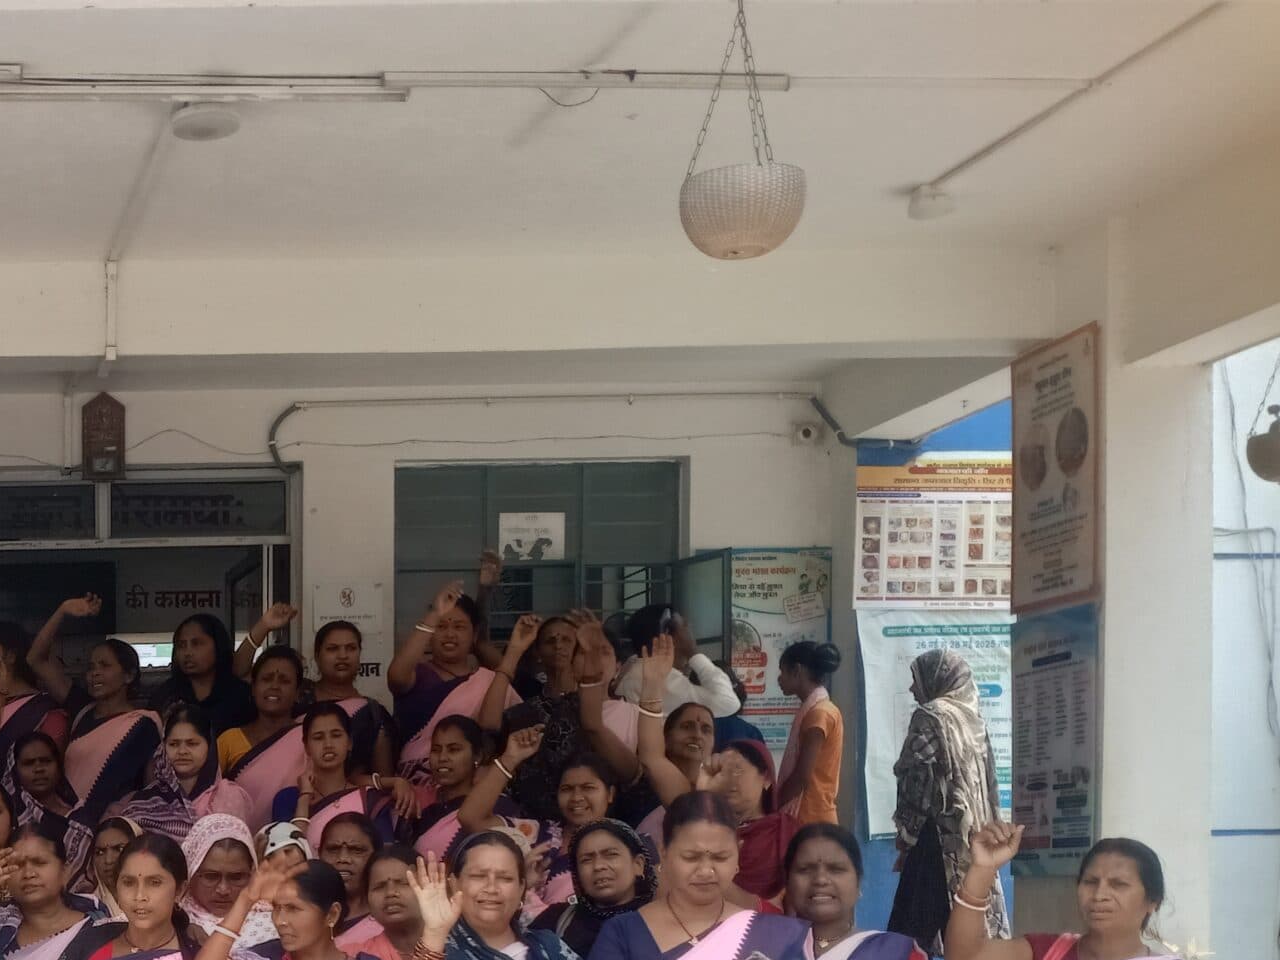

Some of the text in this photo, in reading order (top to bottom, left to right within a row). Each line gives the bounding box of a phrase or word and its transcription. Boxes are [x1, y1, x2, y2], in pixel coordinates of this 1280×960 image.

[126, 584, 149, 609] की
[154, 590, 222, 609] कामना
[975, 640, 996, 648] 2025
